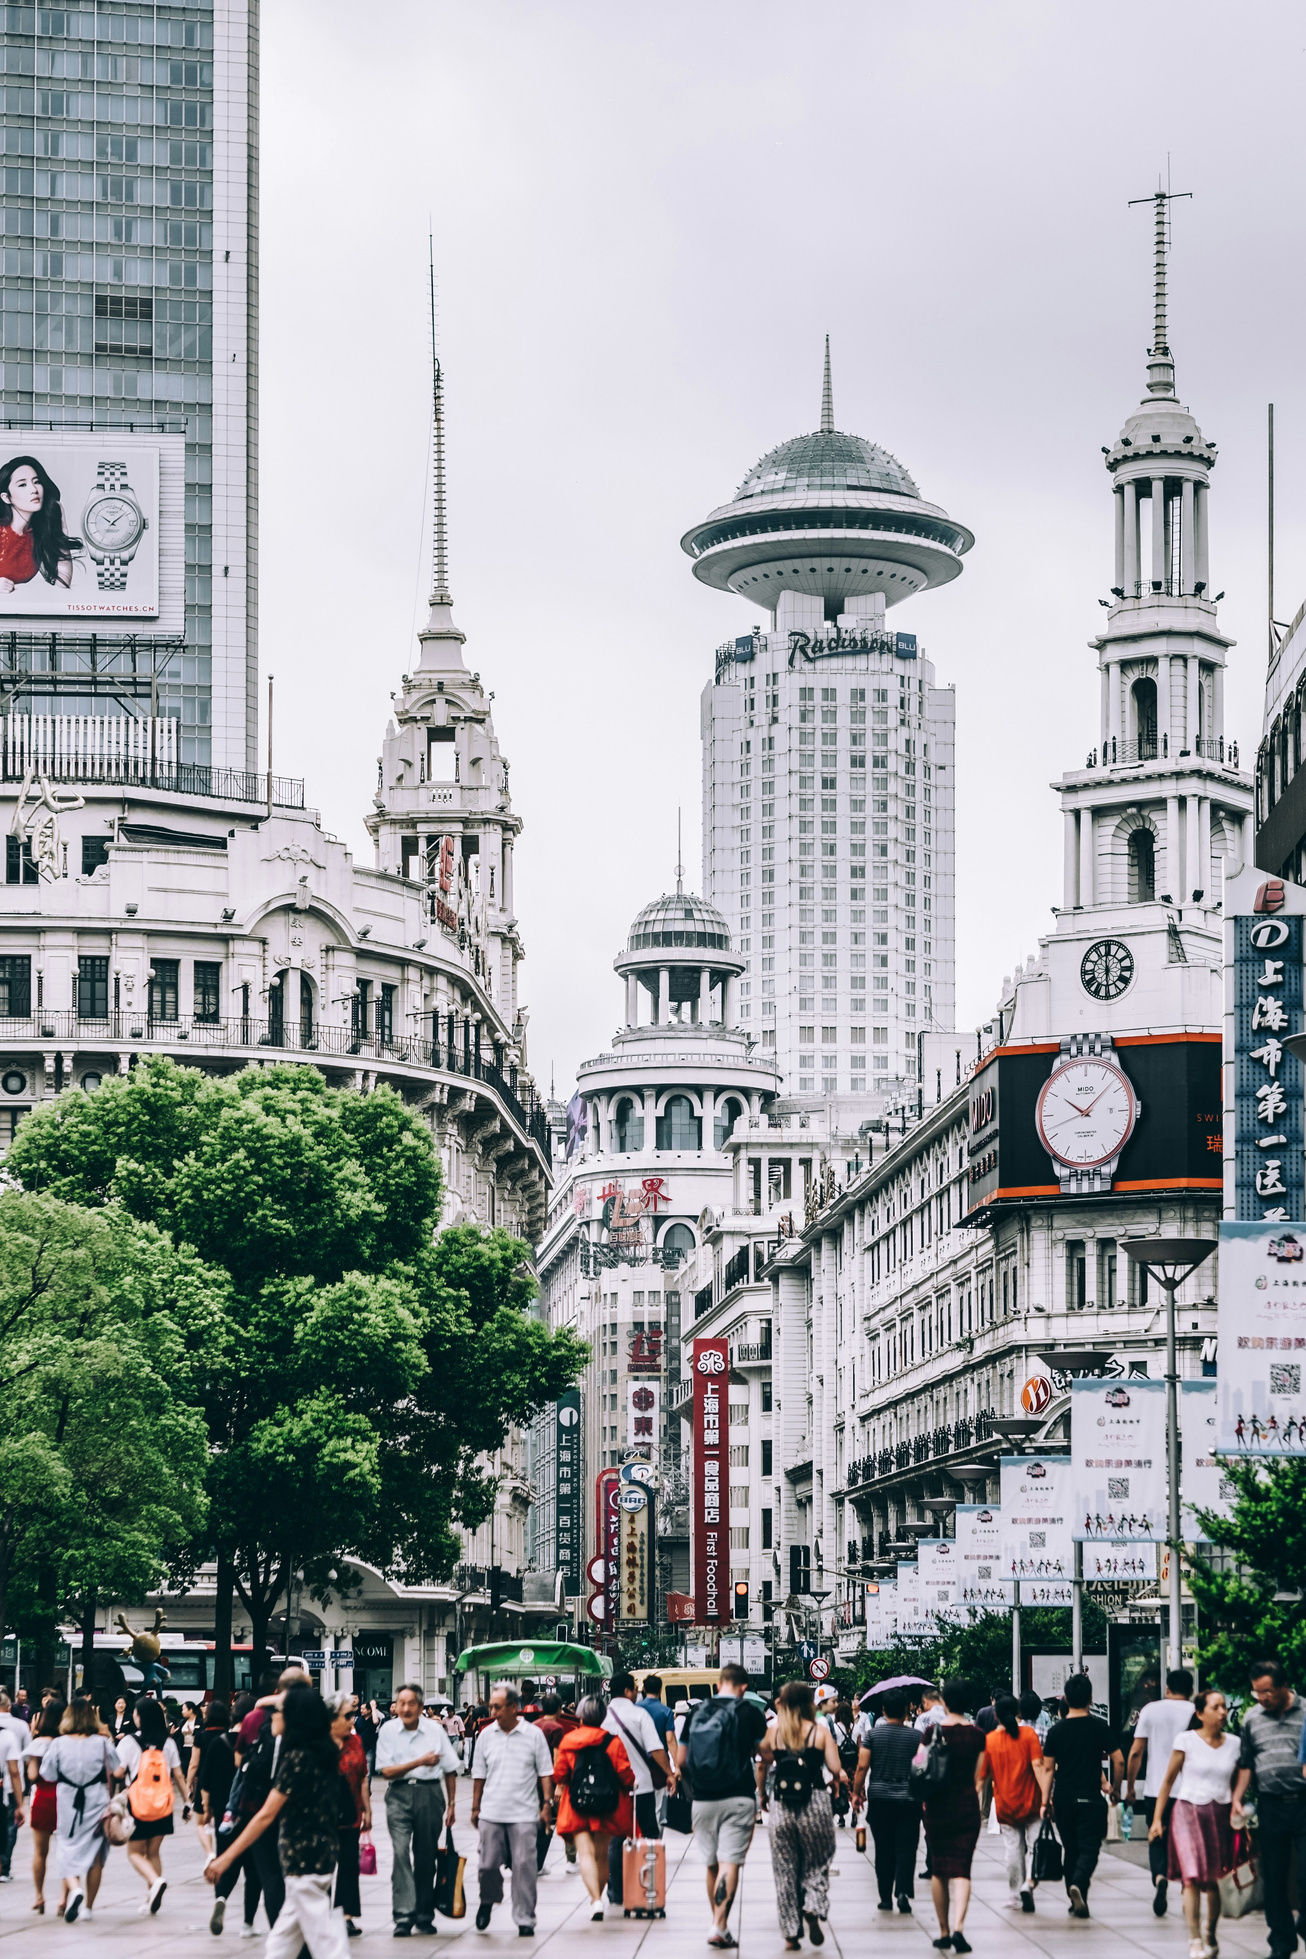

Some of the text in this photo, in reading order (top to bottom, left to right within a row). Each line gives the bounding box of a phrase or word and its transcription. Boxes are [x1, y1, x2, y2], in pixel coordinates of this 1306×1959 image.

[67, 604, 155, 612] TISSOTWATCHES.CN
[736, 645, 751, 655] BLU
[788, 625, 894, 668] Radisson
[898, 641, 916, 652] BLU
[971, 1086, 993, 1136] MIDO
[1197, 1113, 1223, 1122] SWI
[703, 1381, 720, 1523] 上海市第一食品商店
[559, 1433, 571, 1579] 上海市第一百货商店
[706, 1532, 718, 1616] First Foodhall
